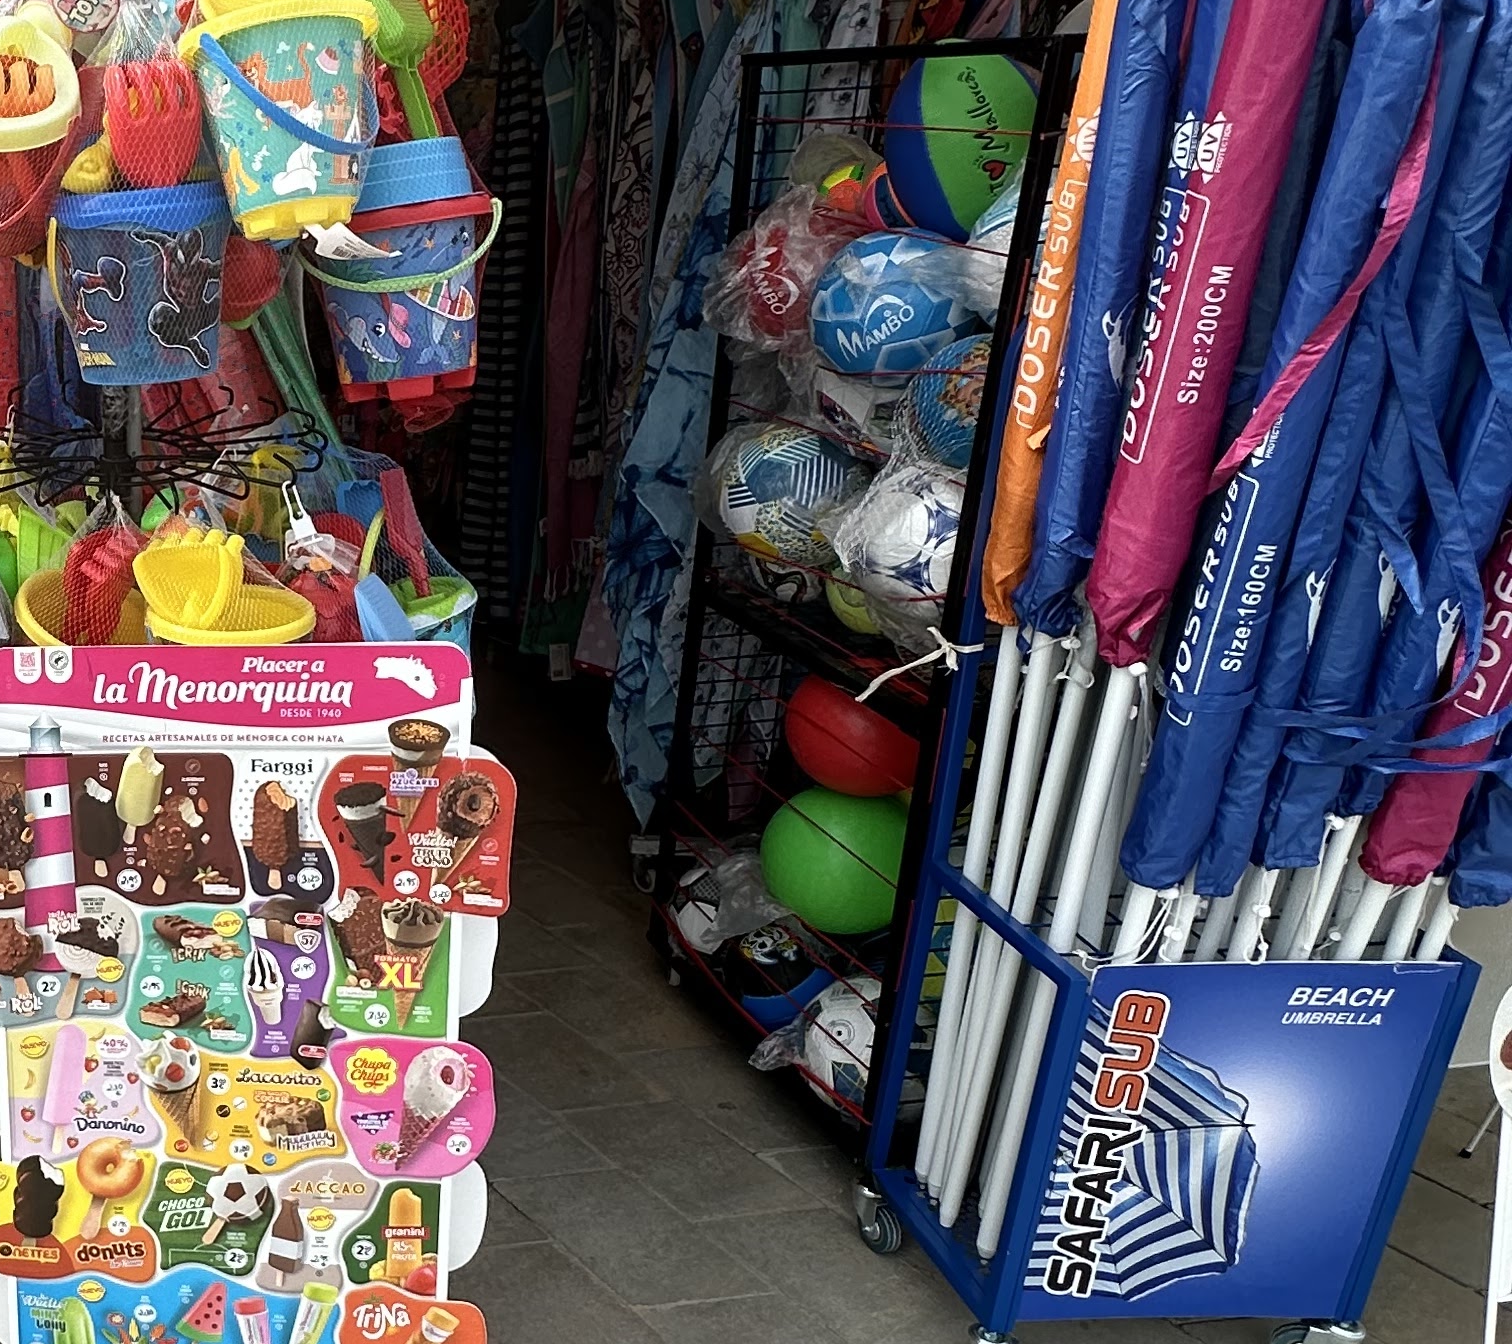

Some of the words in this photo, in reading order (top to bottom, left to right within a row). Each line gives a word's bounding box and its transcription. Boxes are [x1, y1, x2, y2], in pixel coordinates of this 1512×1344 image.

[1199, 131, 1220, 163] UV
[1014, 260, 1065, 416] DOSER
[1049, 187, 1076, 256] SUB
[836, 302, 915, 364] MAMBO
[1177, 264, 1234, 405] Size:200CM
[1214, 479, 1240, 547] SUB
[1220, 544, 1278, 672] Size:160CM
[241, 656, 304, 674] Placer
[310, 658, 326, 674] a
[93, 673, 129, 704] la
[129, 661, 355, 713] Menorquina
[280, 708, 312, 718] DESDE
[317, 708, 342, 718] 1940
[102, 734, 146, 743] RECETAS
[148, 734, 218, 742] ARTESANALES
[221, 734, 234, 742] DE
[237, 734, 289, 743] MENORCA
[291, 734, 316, 743] CON
[318, 734, 345, 743] NATA
[250, 758, 314, 776] Farggi
[301, 935, 315, 946] 57
[379, 962, 423, 989] XL
[1287, 986, 1396, 1008] BEACH
[1280, 1010, 1384, 1027] UMBRELLA
[1094, 992, 1168, 1112] SUB
[352, 1057, 392, 1073] Chupa
[236, 1068, 322, 1086] Lacasitos
[350, 1068, 391, 1088] Chups
[74, 1117, 146, 1135] Danonino
[290, 1182, 367, 1194] LACCAO
[158, 1197, 206, 1212] CHOCO
[1046, 1118, 1144, 1296] SAFARI
[166, 1210, 208, 1230] GOL
[384, 1227, 426, 1238] granini
[76, 1241, 146, 1262] donuts
